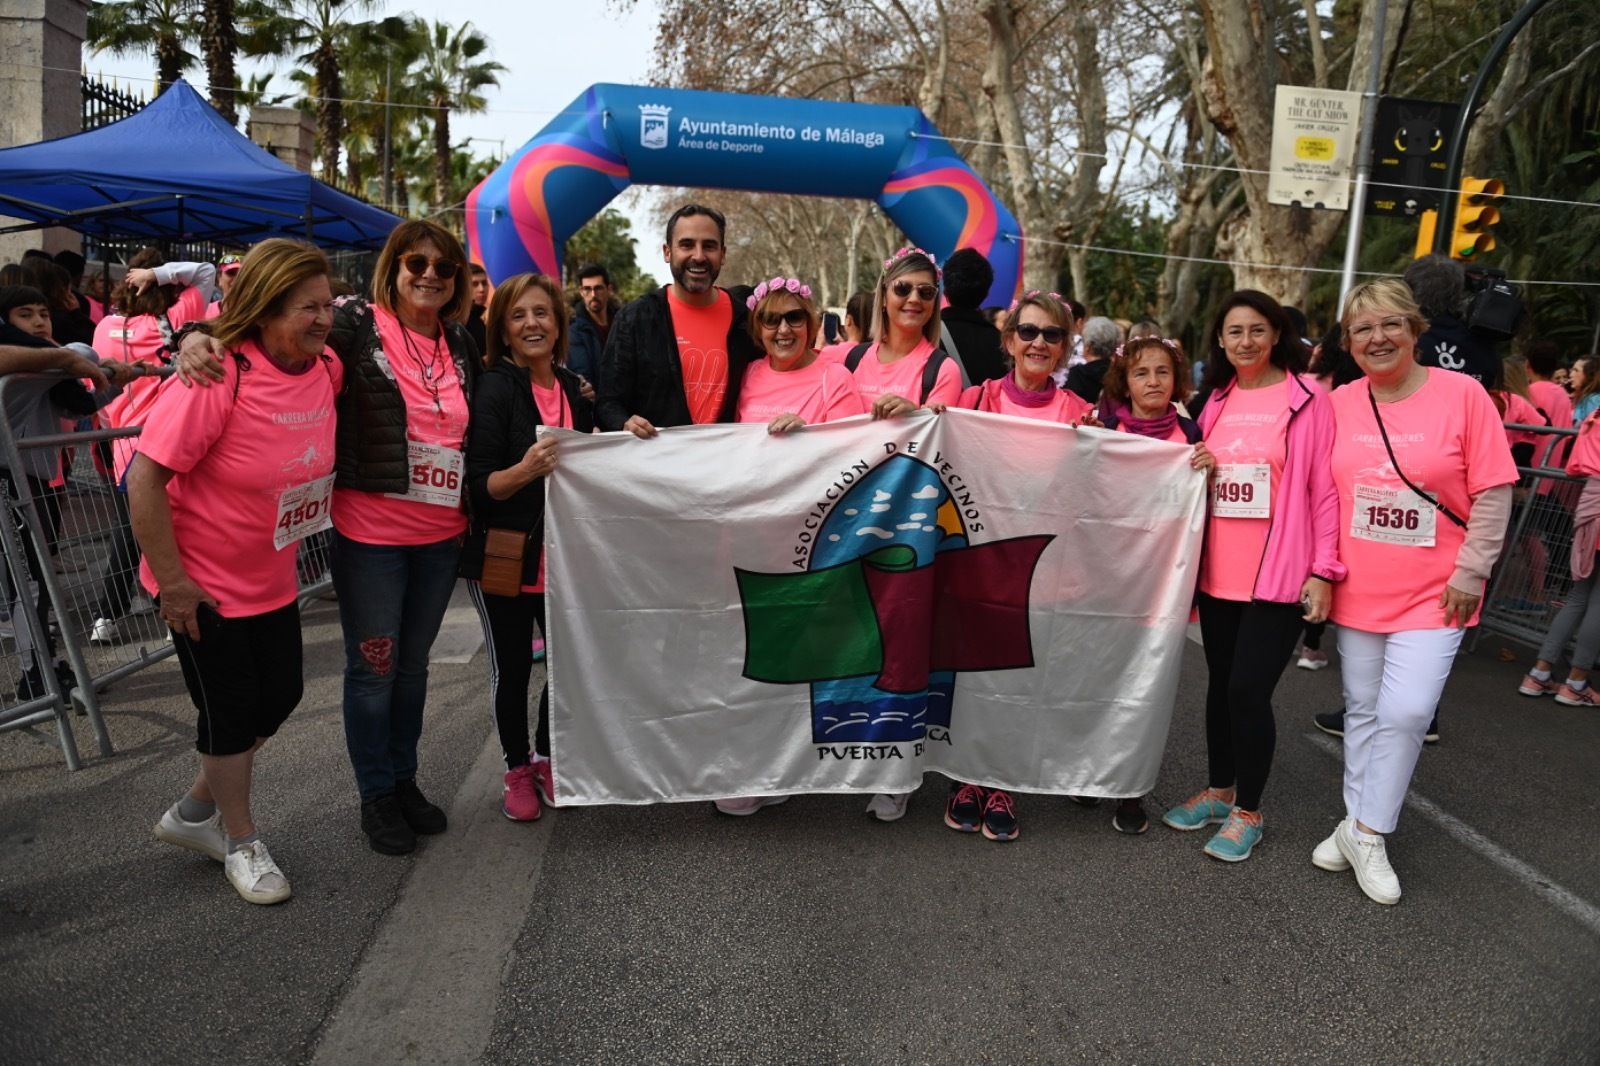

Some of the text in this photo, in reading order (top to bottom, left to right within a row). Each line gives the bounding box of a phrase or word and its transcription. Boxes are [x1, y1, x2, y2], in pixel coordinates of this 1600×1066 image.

[1306, 108, 1323, 119] CAT
[1324, 110, 1349, 120] SHOW
[678, 117, 885, 148] Ayuntamiento de Málaga
[678, 137, 764, 153] Área de Deporte
[1215, 482, 1254, 503] 1499
[277, 494, 330, 530] 4501
[792, 441, 985, 569] ASOCIACIÓN DE VECINOS
[1367, 505, 1420, 530] 1536
[816, 744, 904, 761] PUERTA
